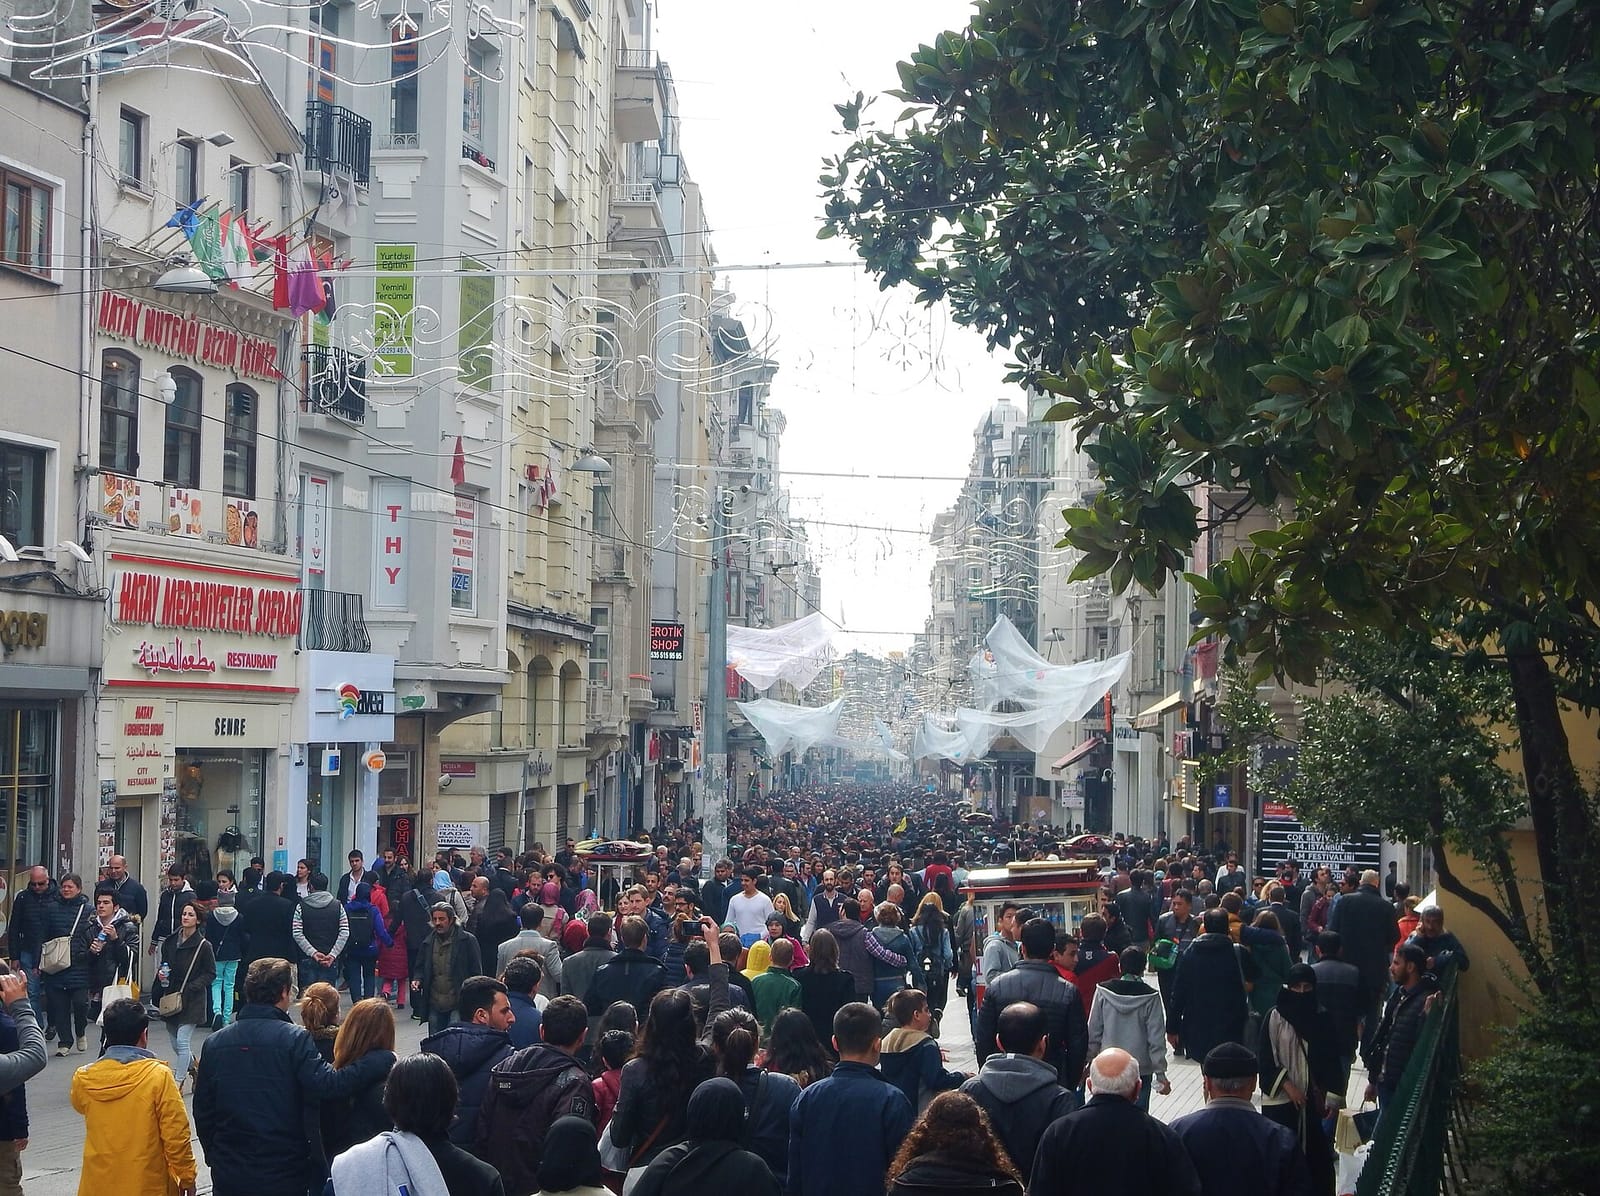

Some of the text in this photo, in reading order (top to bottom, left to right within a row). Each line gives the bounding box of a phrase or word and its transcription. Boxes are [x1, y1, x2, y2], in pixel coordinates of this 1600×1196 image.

[100, 291, 142, 338] HATAY
[144, 308, 200, 355] MUTFAĞI
[202, 326, 239, 366] BİZİM
[384, 506, 402, 585] THY
[119, 572, 302, 636] HATAY MEDENİYETLER SOFRASI
[650, 626, 682, 637] EROTİK
[652, 639, 679, 650] SHOP
[227, 652, 278, 669] RESTAURANT
[137, 767, 148, 775] CITY
[1287, 852, 1305, 860] FİLM
